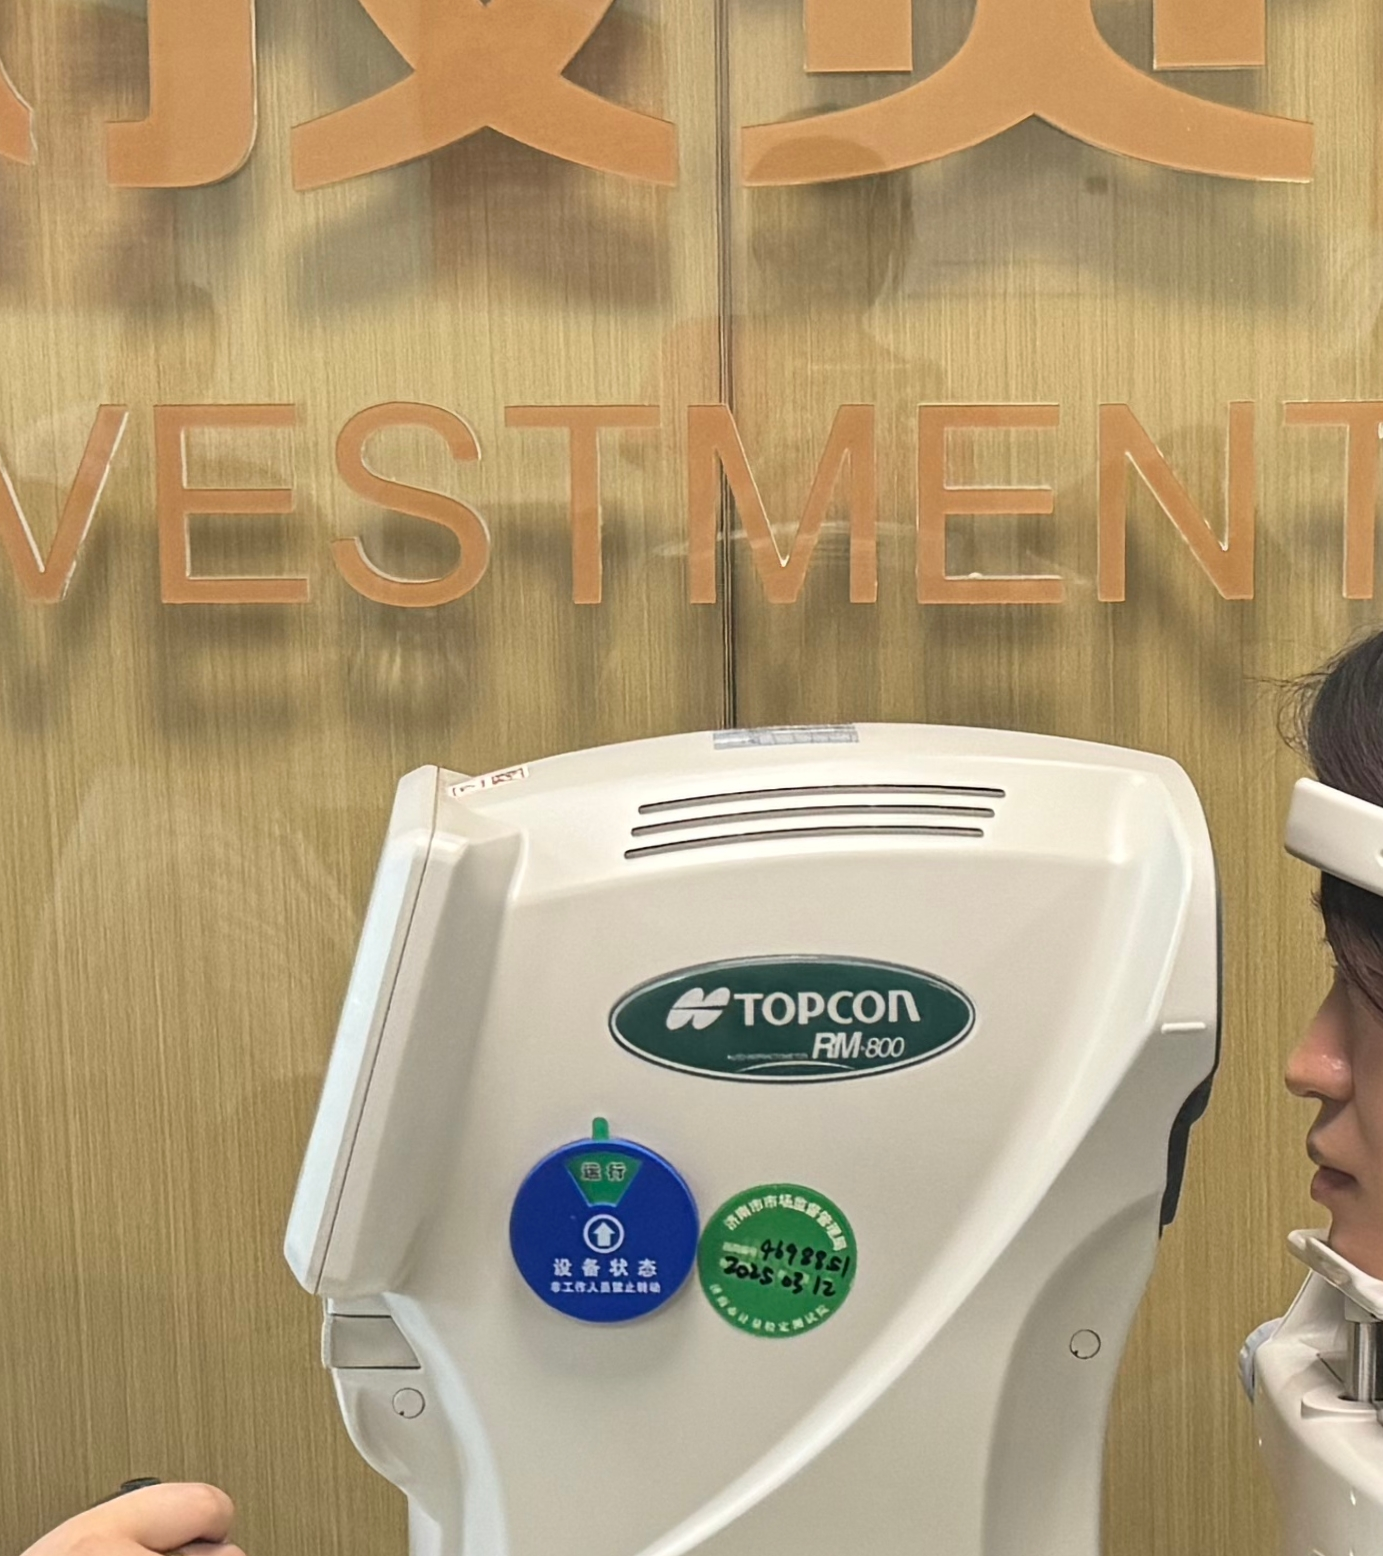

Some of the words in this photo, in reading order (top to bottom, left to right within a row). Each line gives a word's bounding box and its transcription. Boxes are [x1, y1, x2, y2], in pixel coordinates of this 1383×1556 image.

[733, 990, 921, 1026] TOPCON
[581, 1161, 626, 1182] 运行
[723, 1193, 848, 1251] 济南市市场监督管理局
[553, 1258, 658, 1278] 设备状态
[723, 1256, 774, 1286] 2025
[781, 1271, 804, 1294] 03
[813, 1276, 836, 1297] 12
